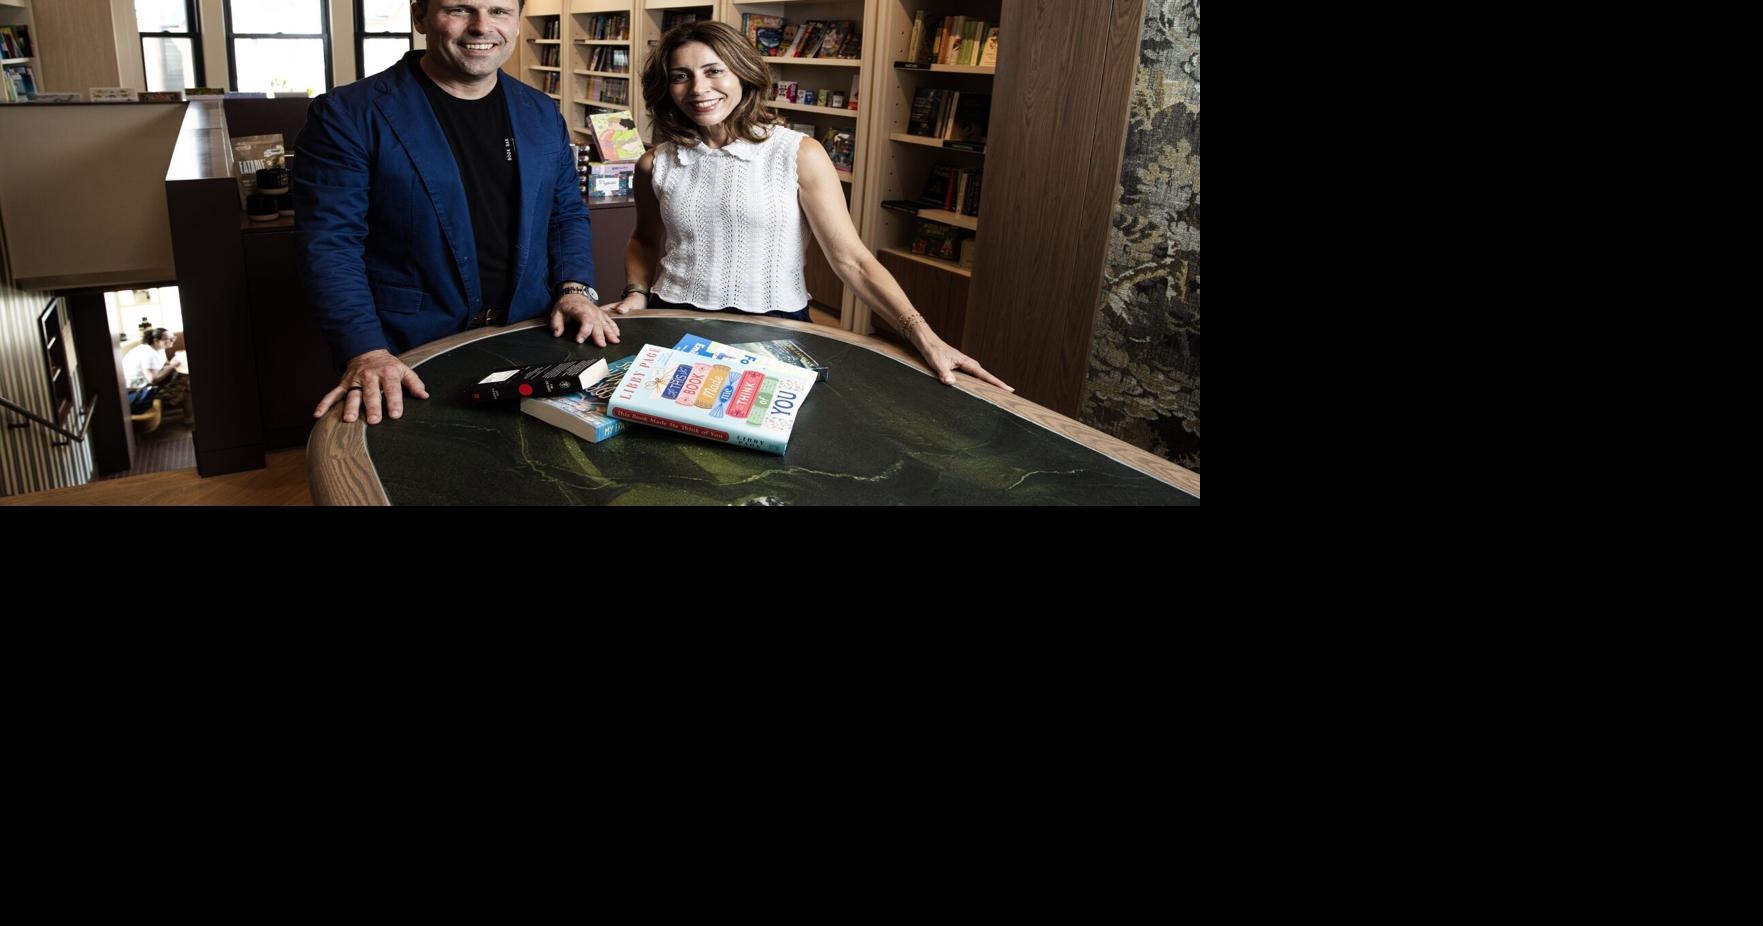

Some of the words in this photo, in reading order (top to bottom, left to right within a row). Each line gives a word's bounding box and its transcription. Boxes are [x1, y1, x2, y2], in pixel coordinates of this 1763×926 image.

[619, 370, 645, 400] LIBBY
[672, 374, 686, 391] THIS
[684, 373, 702, 396] BOOK
[703, 375, 724, 399] Made
[736, 382, 756, 406] THINK
[759, 394, 770, 405] of
[771, 390, 798, 416] YOU
[681, 424, 699, 434] Think
